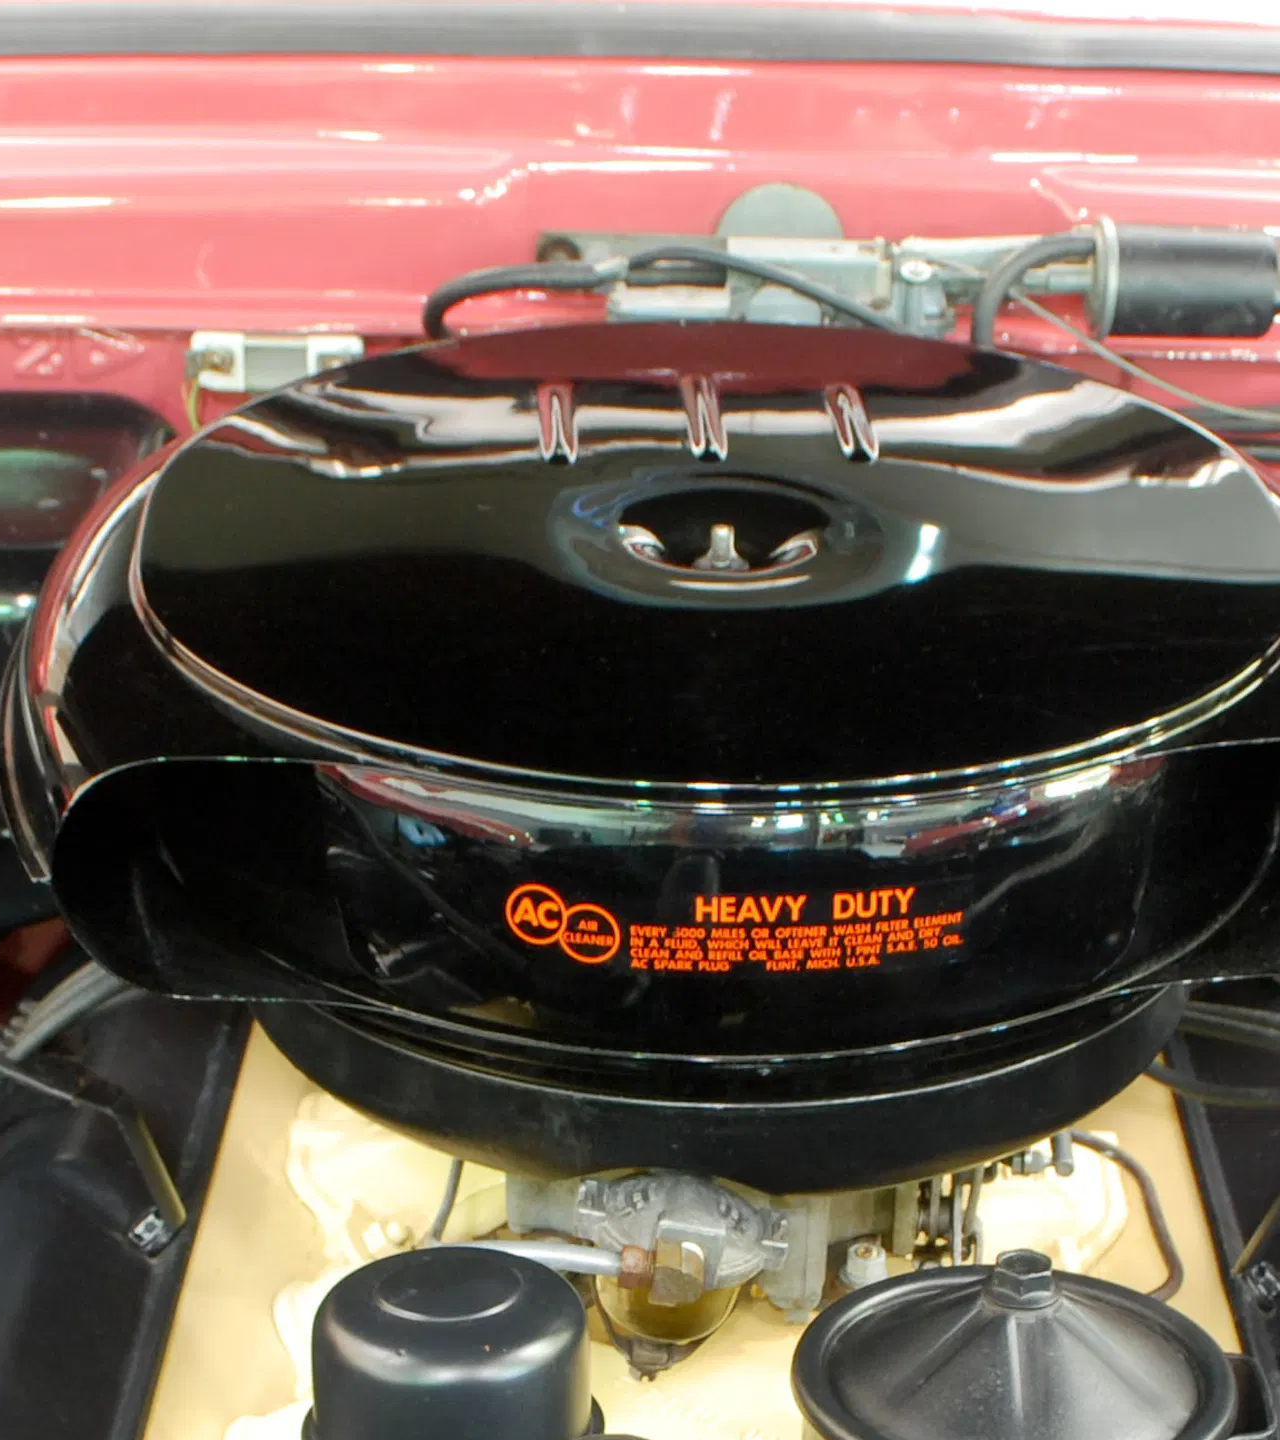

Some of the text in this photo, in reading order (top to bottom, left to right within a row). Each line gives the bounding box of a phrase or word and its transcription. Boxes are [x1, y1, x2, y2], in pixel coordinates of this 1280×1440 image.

[513, 896, 560, 929] AC
[694, 886, 916, 924] HEAVY DUTY
[577, 919, 599, 932] AIR
[629, 924, 668, 938] EVERY
[710, 927, 746, 939] MILES
[751, 927, 770, 939] OR
[775, 926, 827, 939] OFTENER
[833, 923, 872, 936] WASH
[875, 919, 910, 932] FILTER
[913, 911, 963, 929] ELEMENT
[562, 931, 614, 947] CLEANER
[630, 937, 644, 948] IN
[648, 937, 659, 948] A
[664, 938, 701, 950] FLUID,
[707, 939, 749, 950] WHICH
[754, 939, 782, 949] WILL
[787, 937, 824, 949] LEAVE
[829, 936, 840, 947] IT
[844, 933, 883, 946] CLEAN
[887, 929, 915, 942] AND
[630, 948, 670, 959] CLEAN
[675, 949, 704, 960] AND
[708, 950, 743, 960] REFILL
[748, 950, 768, 960] OIL
[773, 949, 805, 960] BASE
[809, 947, 841, 959] WITH
[855, 943, 881, 955] PINT
[630, 959, 648, 969] AC
[653, 959, 693, 971] SPARK
[698, 960, 730, 972] PLUG
